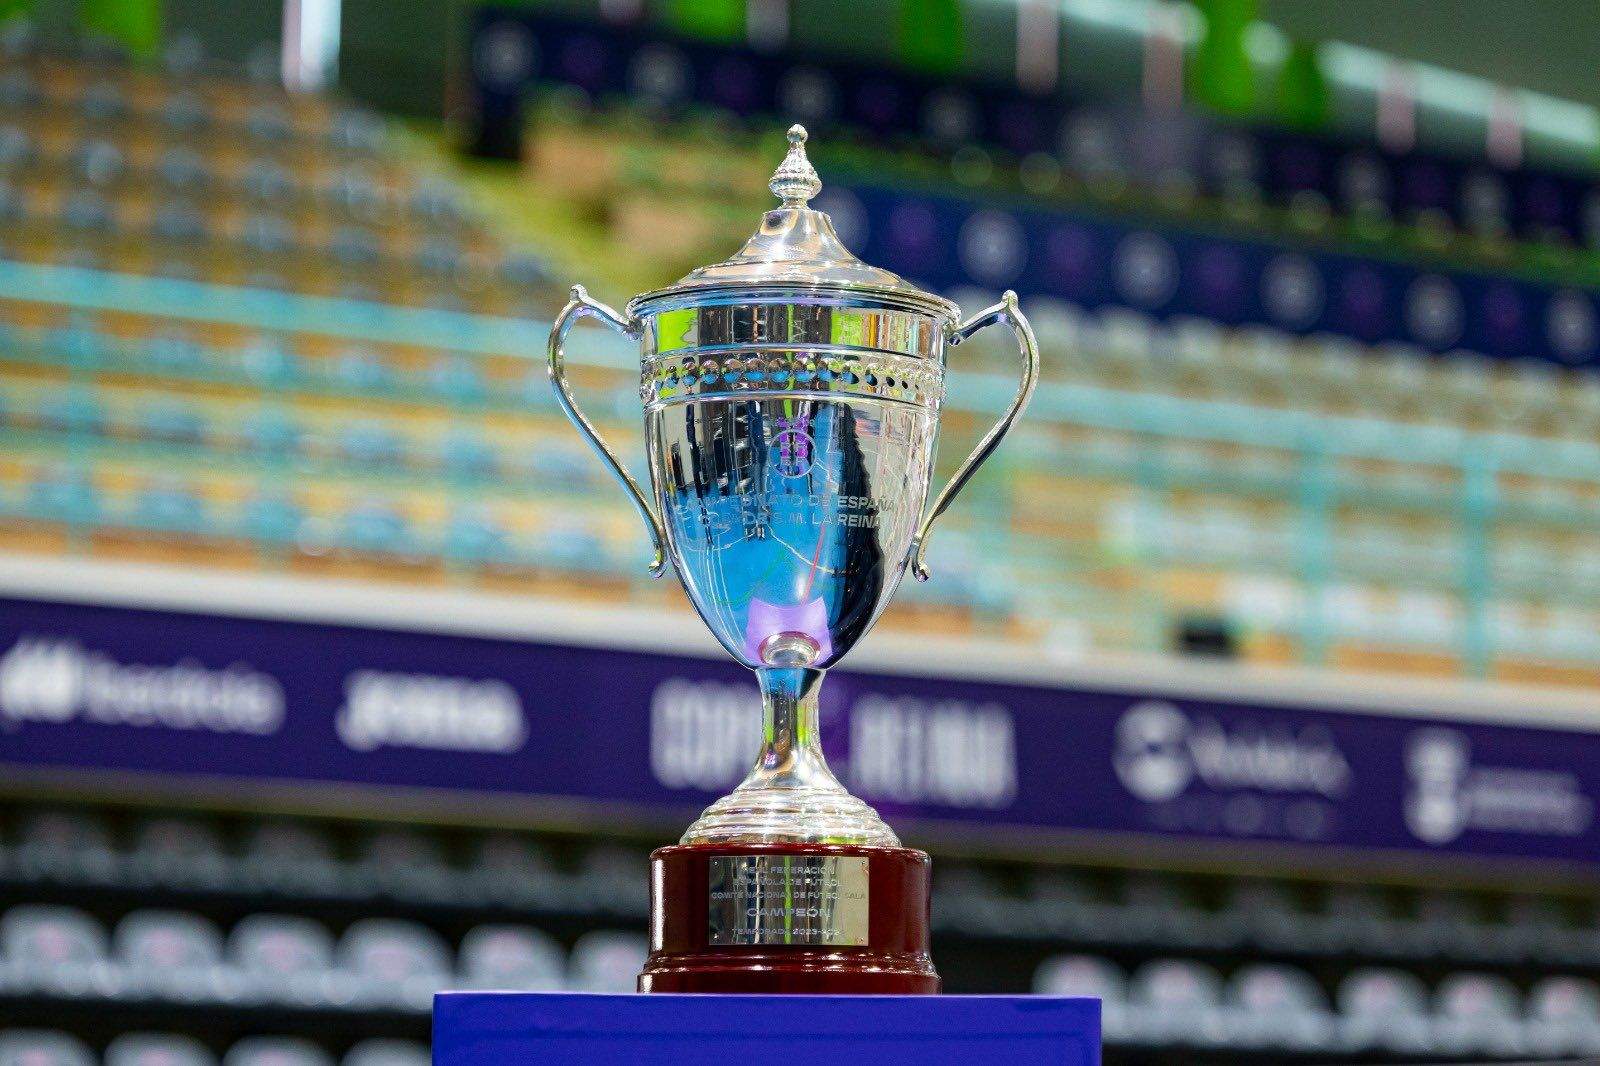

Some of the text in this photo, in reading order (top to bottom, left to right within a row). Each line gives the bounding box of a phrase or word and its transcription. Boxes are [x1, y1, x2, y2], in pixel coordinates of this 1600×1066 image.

[838, 495, 895, 512] ESPAÑA
[812, 512, 833, 525] LA
[837, 513, 881, 528] REINA
[794, 892, 806, 900] DE
[746, 906, 832, 919] CAMPEÓN
